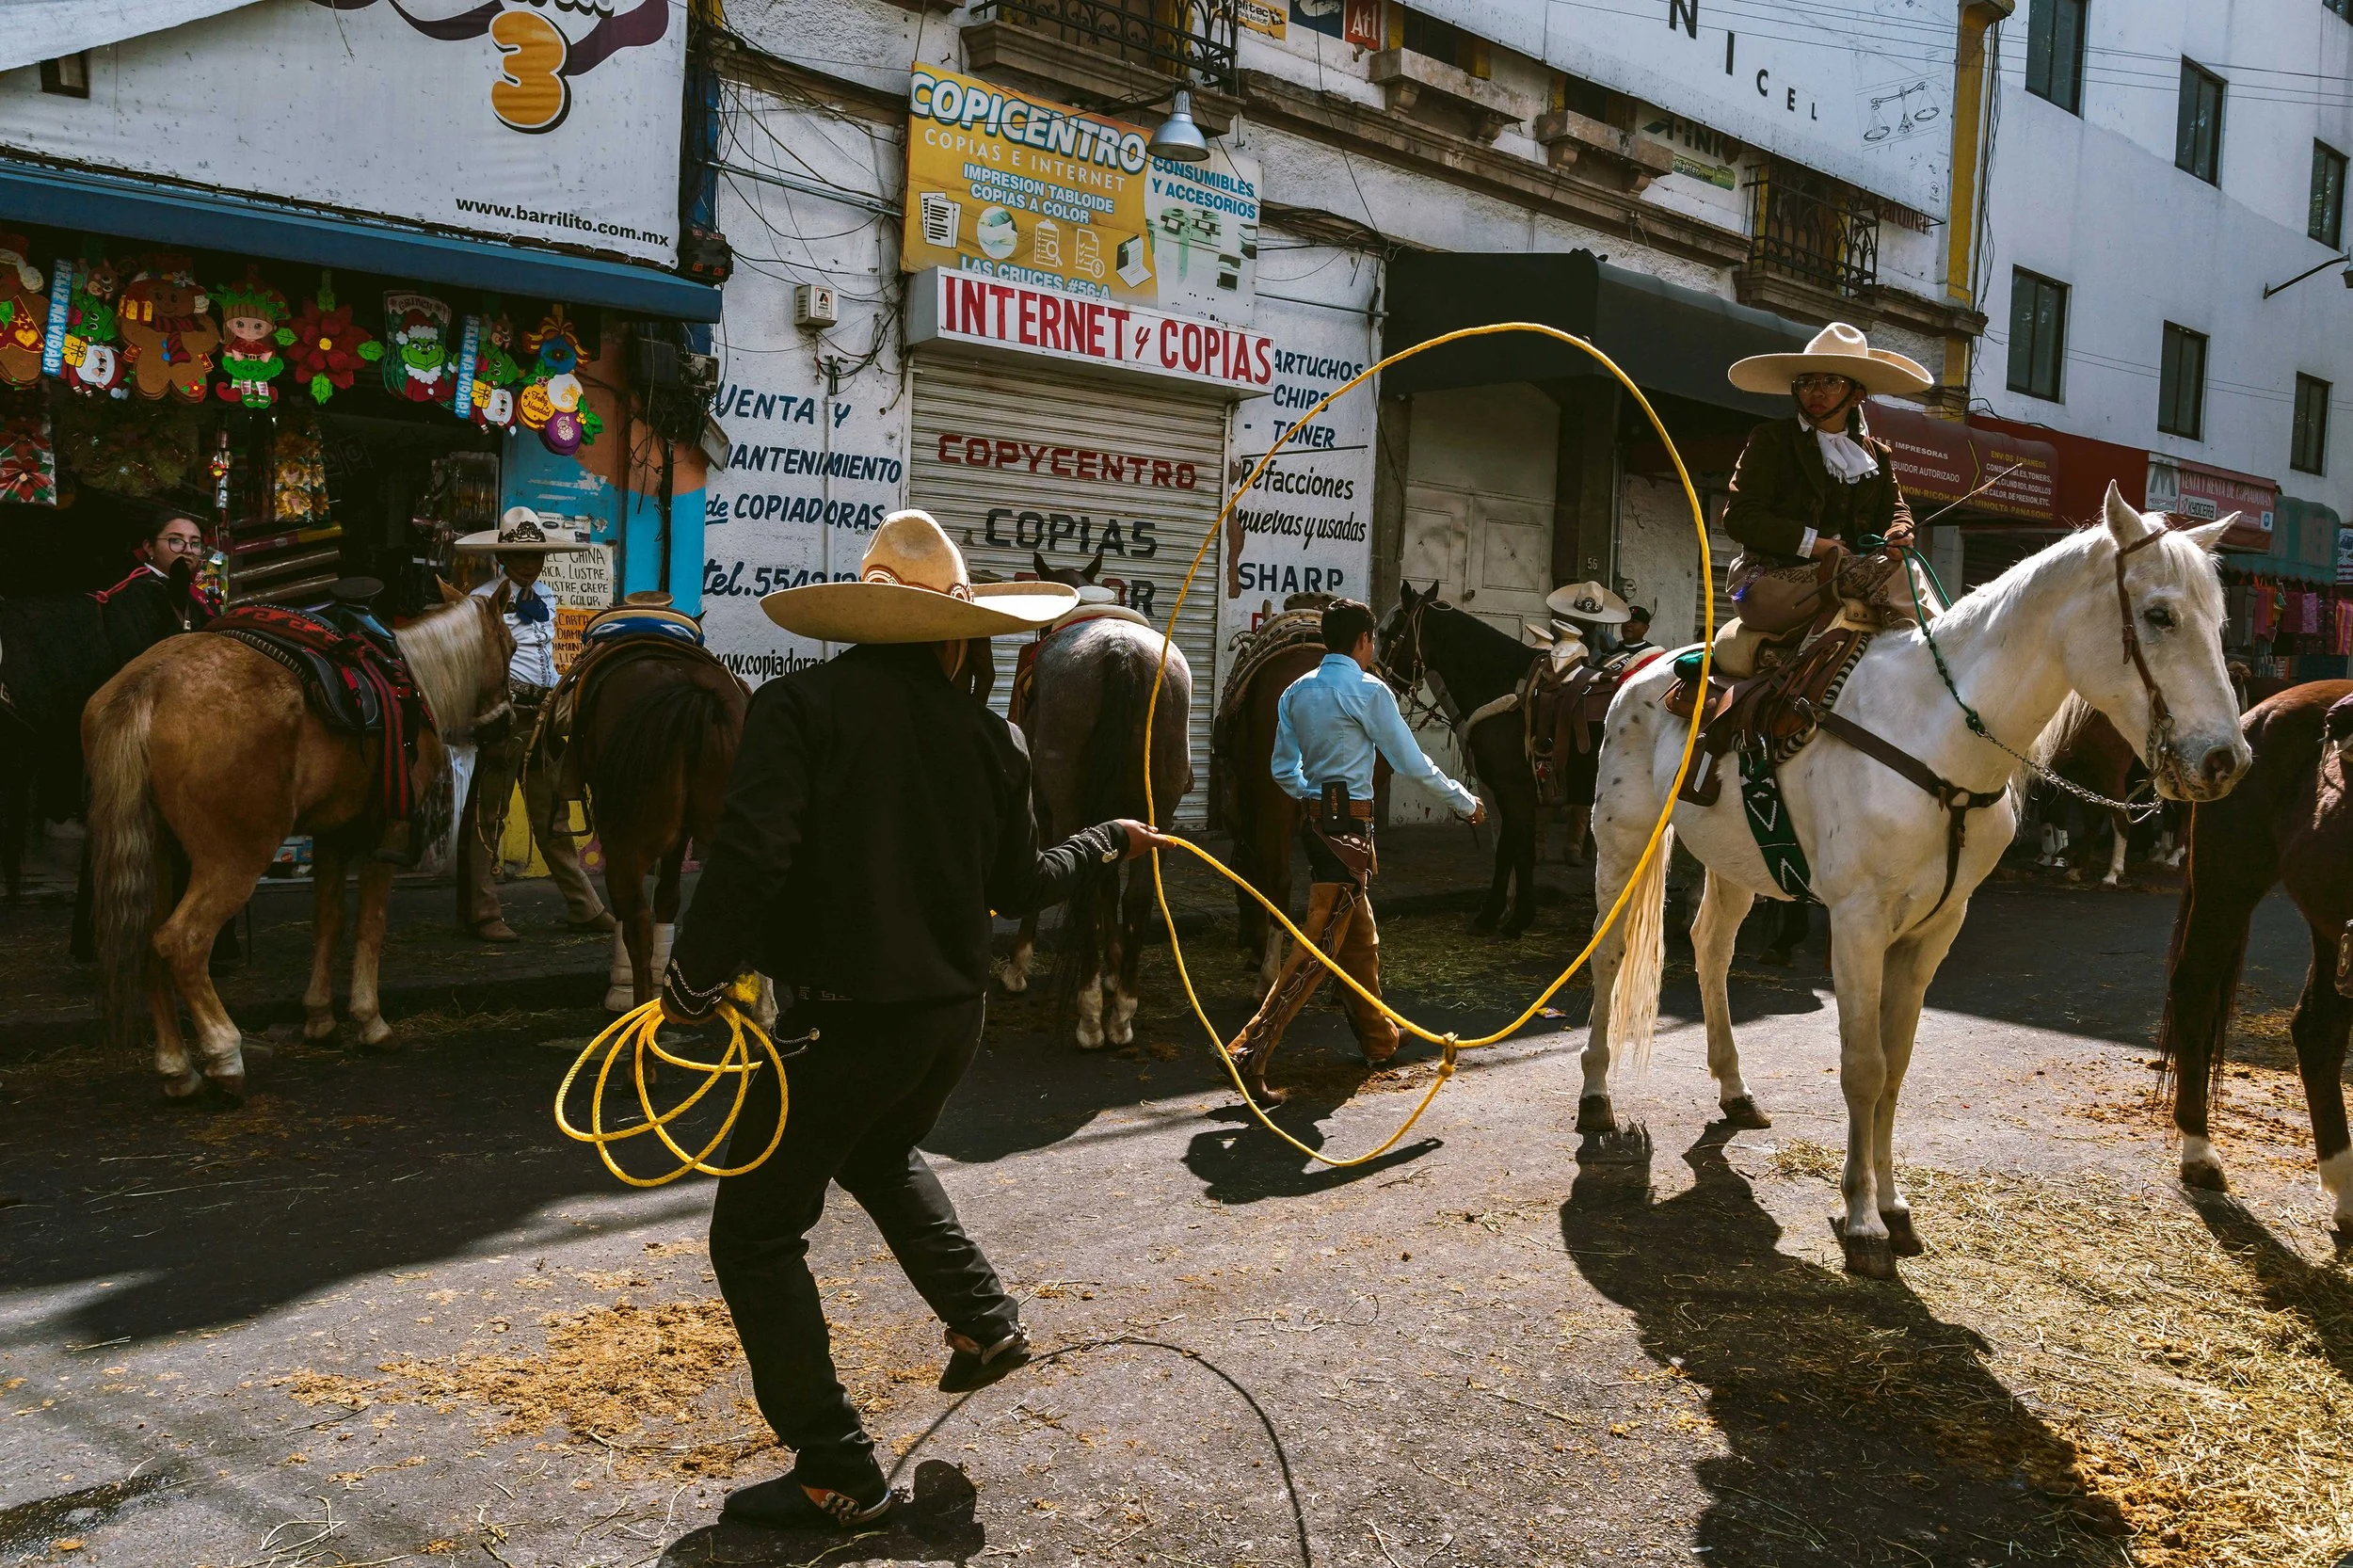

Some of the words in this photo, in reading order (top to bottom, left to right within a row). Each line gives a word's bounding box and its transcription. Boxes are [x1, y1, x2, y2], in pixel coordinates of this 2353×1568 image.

[910, 71, 1147, 175] COPICENTRO
[924, 128, 1001, 162] COPIAS
[1012, 149, 1021, 167] E
[1032, 153, 1126, 192] INTERNET
[1152, 156, 1255, 199] CONSUMIBLES
[963, 162, 1046, 198] IMPRESION
[1047, 184, 1115, 214] TABLOIDE
[970, 183, 1027, 209] COPIAS
[1028, 195, 1040, 213] A
[1042, 200, 1092, 225] COLOR
[1152, 177, 1162, 194] Y
[1165, 181, 1257, 220] ACCESORIOS
[455, 198, 669, 248] www.barrilito.com.mx
[961, 255, 995, 277] LAS
[997, 265, 1065, 291] CRUCES
[944, 275, 1130, 361] INTERNET
[1135, 325, 1151, 360] y
[1160, 318, 1273, 386] COPIAS
[1274, 348, 1364, 382] ARTUCHOS
[522, 400, 552, 418] Navidad
[531, 390, 549, 407] Feliz
[715, 381, 815, 424] VENTA
[1273, 384, 1331, 412] CHIPS
[1273, 420, 1336, 449] TONER
[1896, 441, 1948, 459] IMPRESORAS
[938, 433, 1197, 490] COPYCENTRO
[1239, 458, 1354, 500] Refacciones
[1919, 467, 1960, 483] AUTORIZADO
[705, 494, 729, 518] de
[734, 492, 886, 531] COPIADORAS
[1238, 508, 1302, 537] nuevas
[1304, 517, 1317, 550] y
[1318, 511, 1367, 542] usadas
[2188, 501, 2215, 519] KYOCERA
[985, 508, 1158, 558] COPIAS
[1239, 562, 1344, 594] SHARP
[1587, 557, 1598, 570] 56
